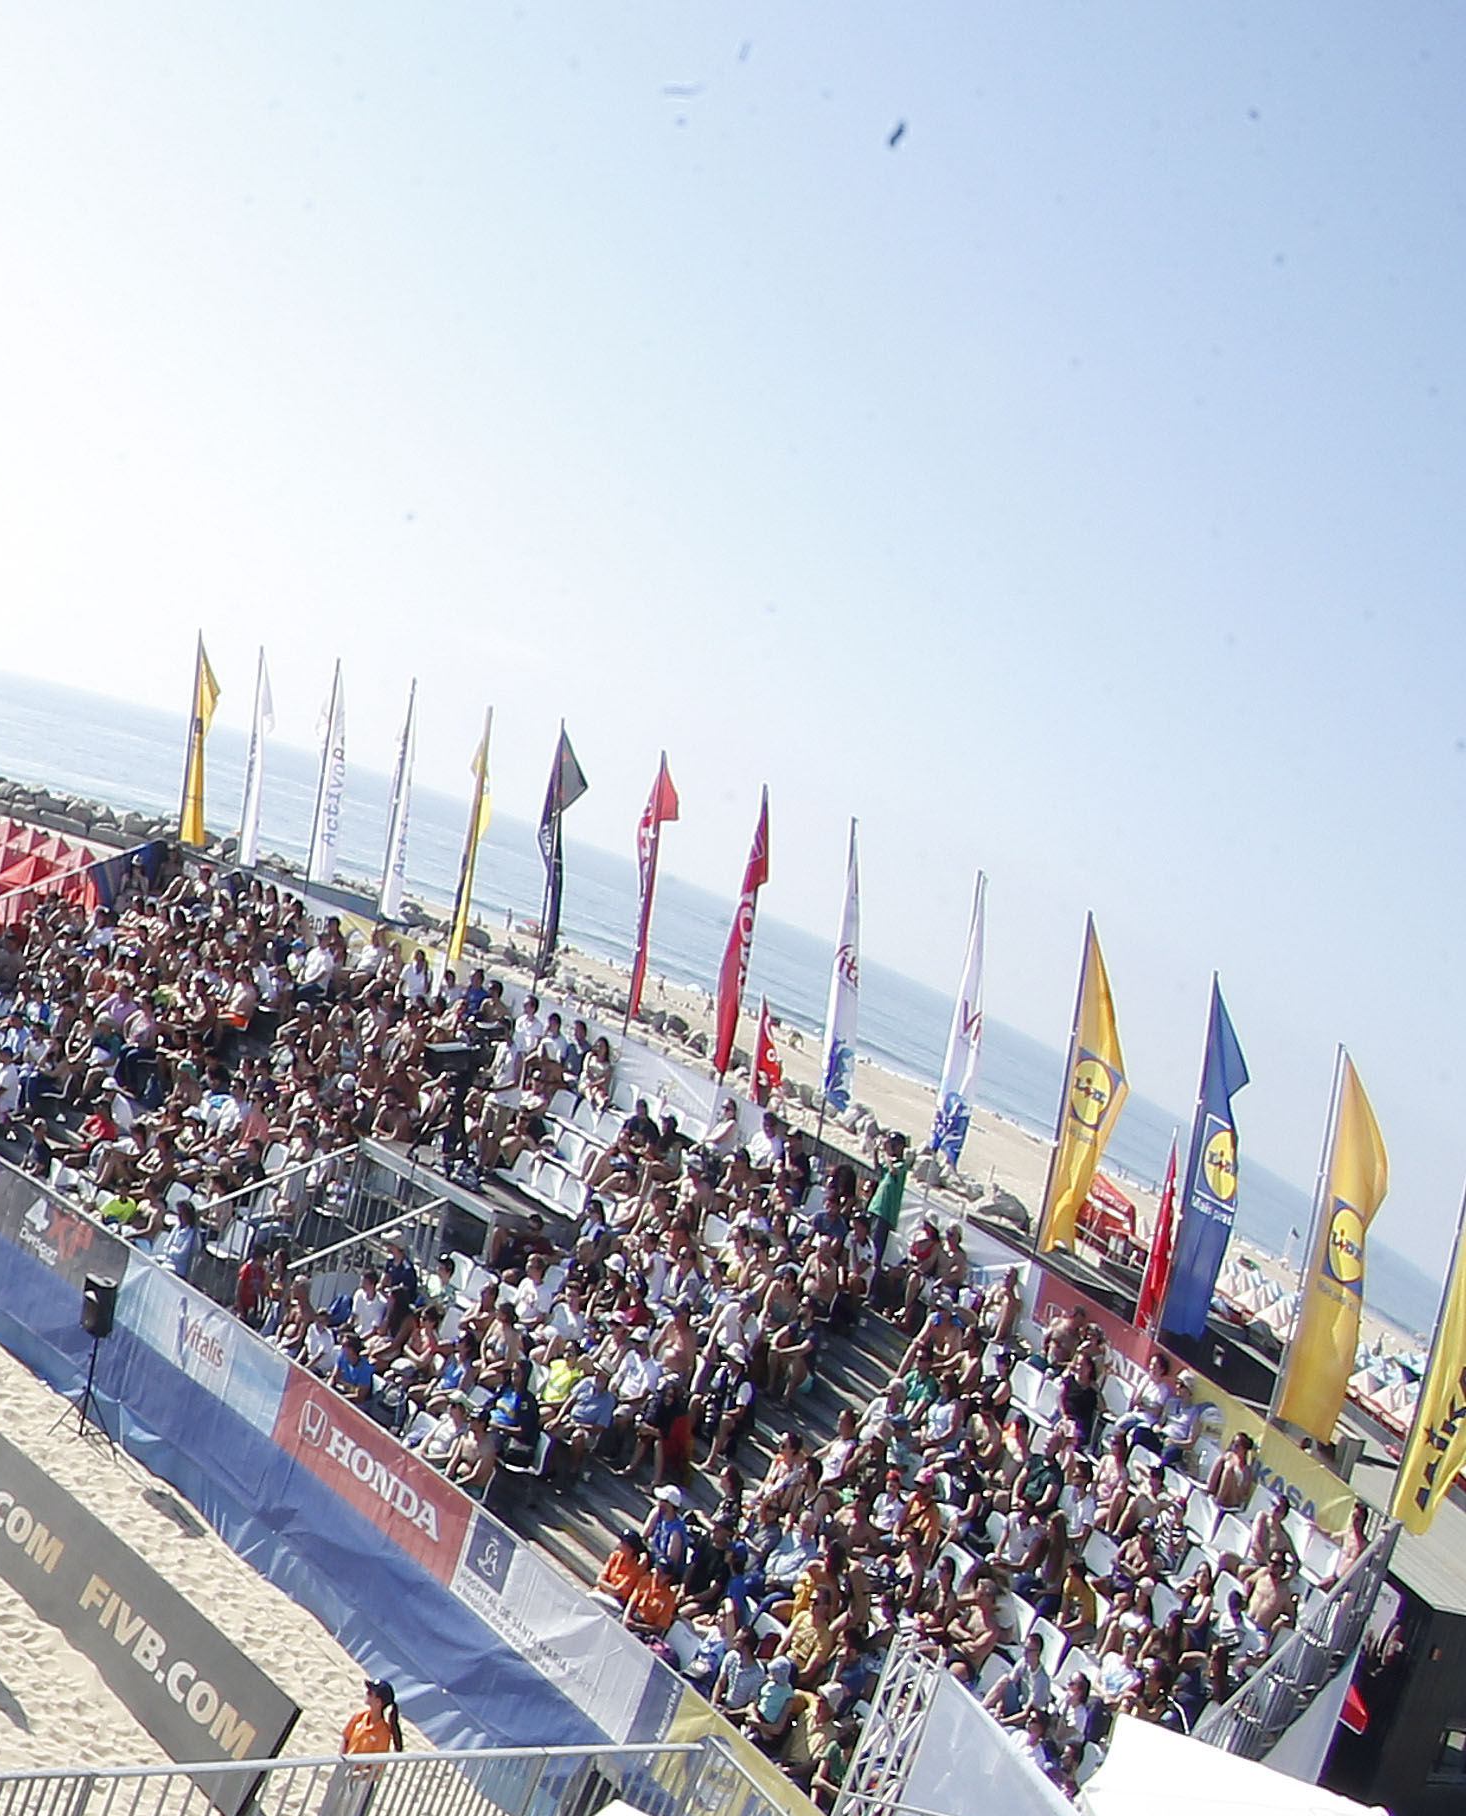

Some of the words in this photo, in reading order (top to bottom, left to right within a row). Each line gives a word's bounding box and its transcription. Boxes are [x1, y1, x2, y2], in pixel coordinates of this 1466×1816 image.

[182, 1317, 225, 1369] Vitalis
[324, 1428, 444, 1544] HONDA
[78, 1572, 258, 1760] FIVB.COM
